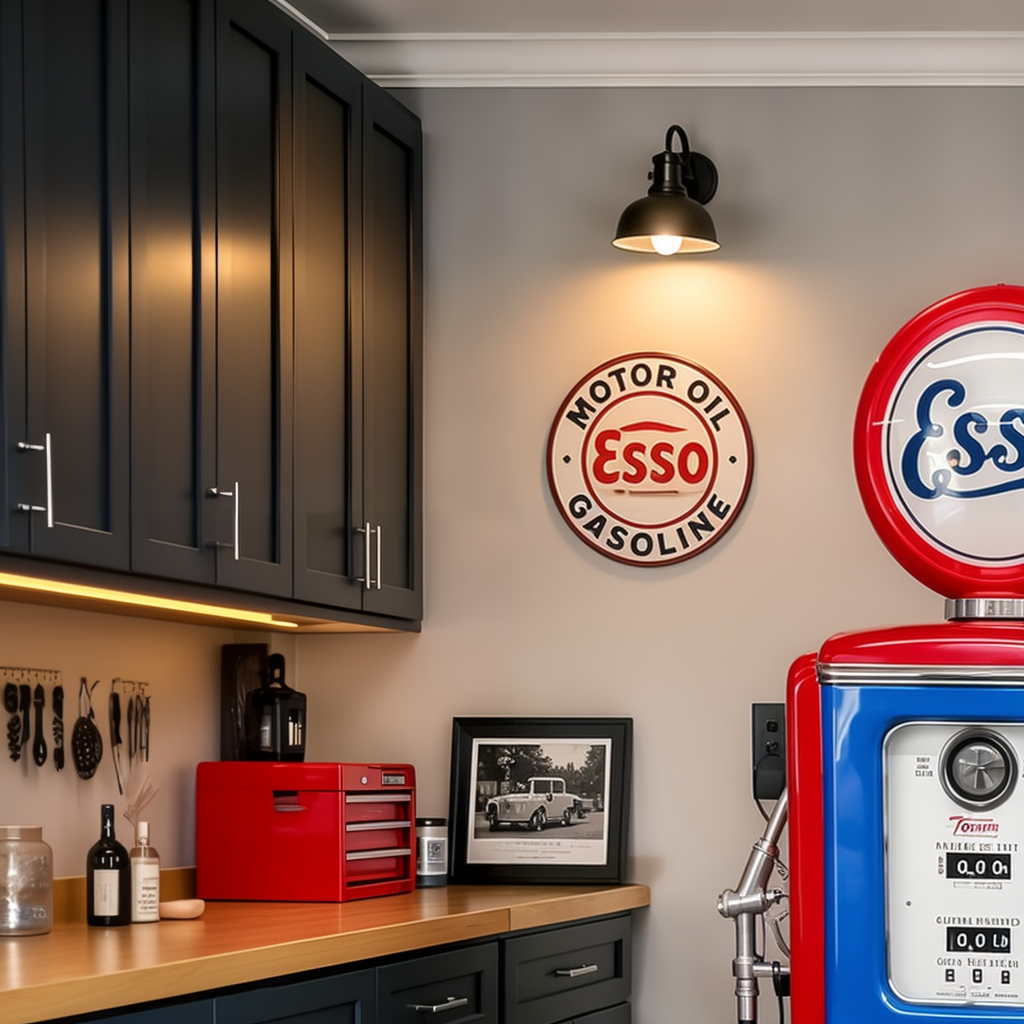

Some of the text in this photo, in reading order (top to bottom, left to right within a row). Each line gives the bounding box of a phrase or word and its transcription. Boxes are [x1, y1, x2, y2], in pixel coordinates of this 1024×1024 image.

[566, 363, 730, 432] MOTOR OIL
[568, 493, 732, 557] GASOLINE
